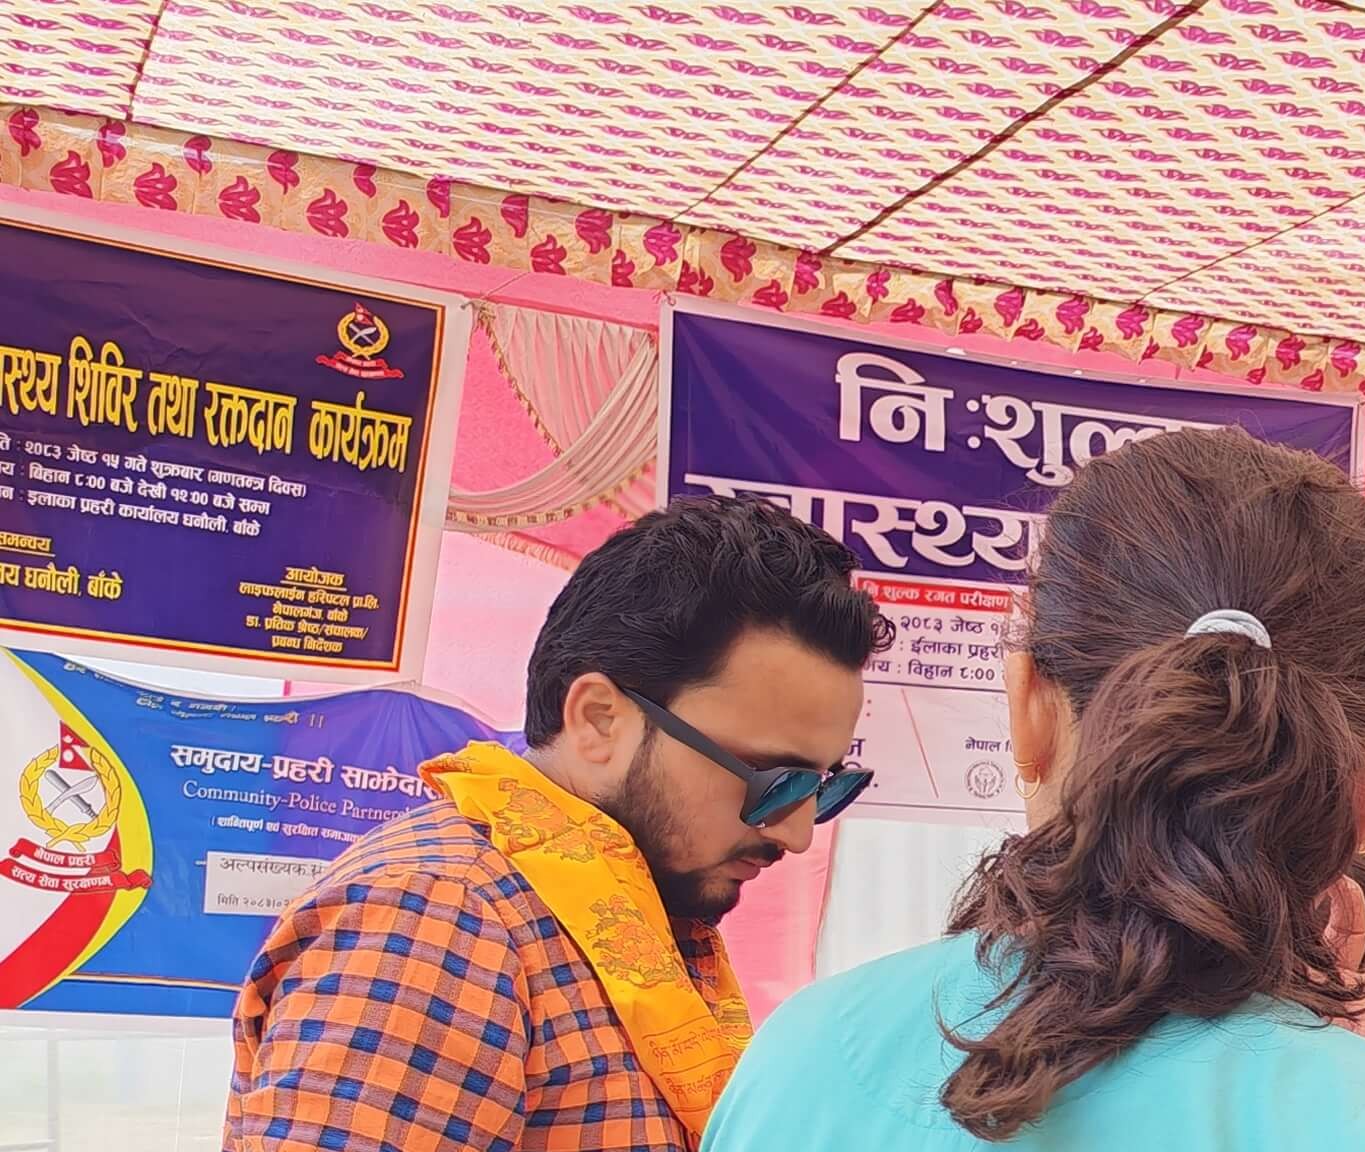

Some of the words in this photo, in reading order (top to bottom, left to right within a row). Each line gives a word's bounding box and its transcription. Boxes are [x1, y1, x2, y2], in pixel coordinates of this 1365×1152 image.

[67, 336, 143, 433] शिविर
[148, 372, 199, 438] तथा
[204, 382, 298, 455] रक्तदान
[309, 391, 413, 473] कार्यक्रम
[67, 444, 98, 464] जेष्ठ
[125, 454, 147, 473] गते
[27, 489, 76, 510] इलाका
[80, 498, 115, 516] प्रहरी
[119, 504, 179, 525] कार्यालय
[110, 476, 133, 494] बजे
[138, 479, 167, 500] देखी
[212, 493, 235, 510] बजे
[239, 497, 271, 515] सम्म
[285, 565, 345, 586] आयोजक
[925, 591, 955, 605] रगत
[960, 592, 1008, 609] परीक्षण
[900, 616, 943, 633] २०८३
[950, 615, 985, 634] जेष्ठ
[965, 736, 1001, 752] नेपाल
[171, 745, 335, 785] समुदाय-प्रहरी
[183, 779, 337, 814] Community-Police
[217, 892, 239, 906] मिति
